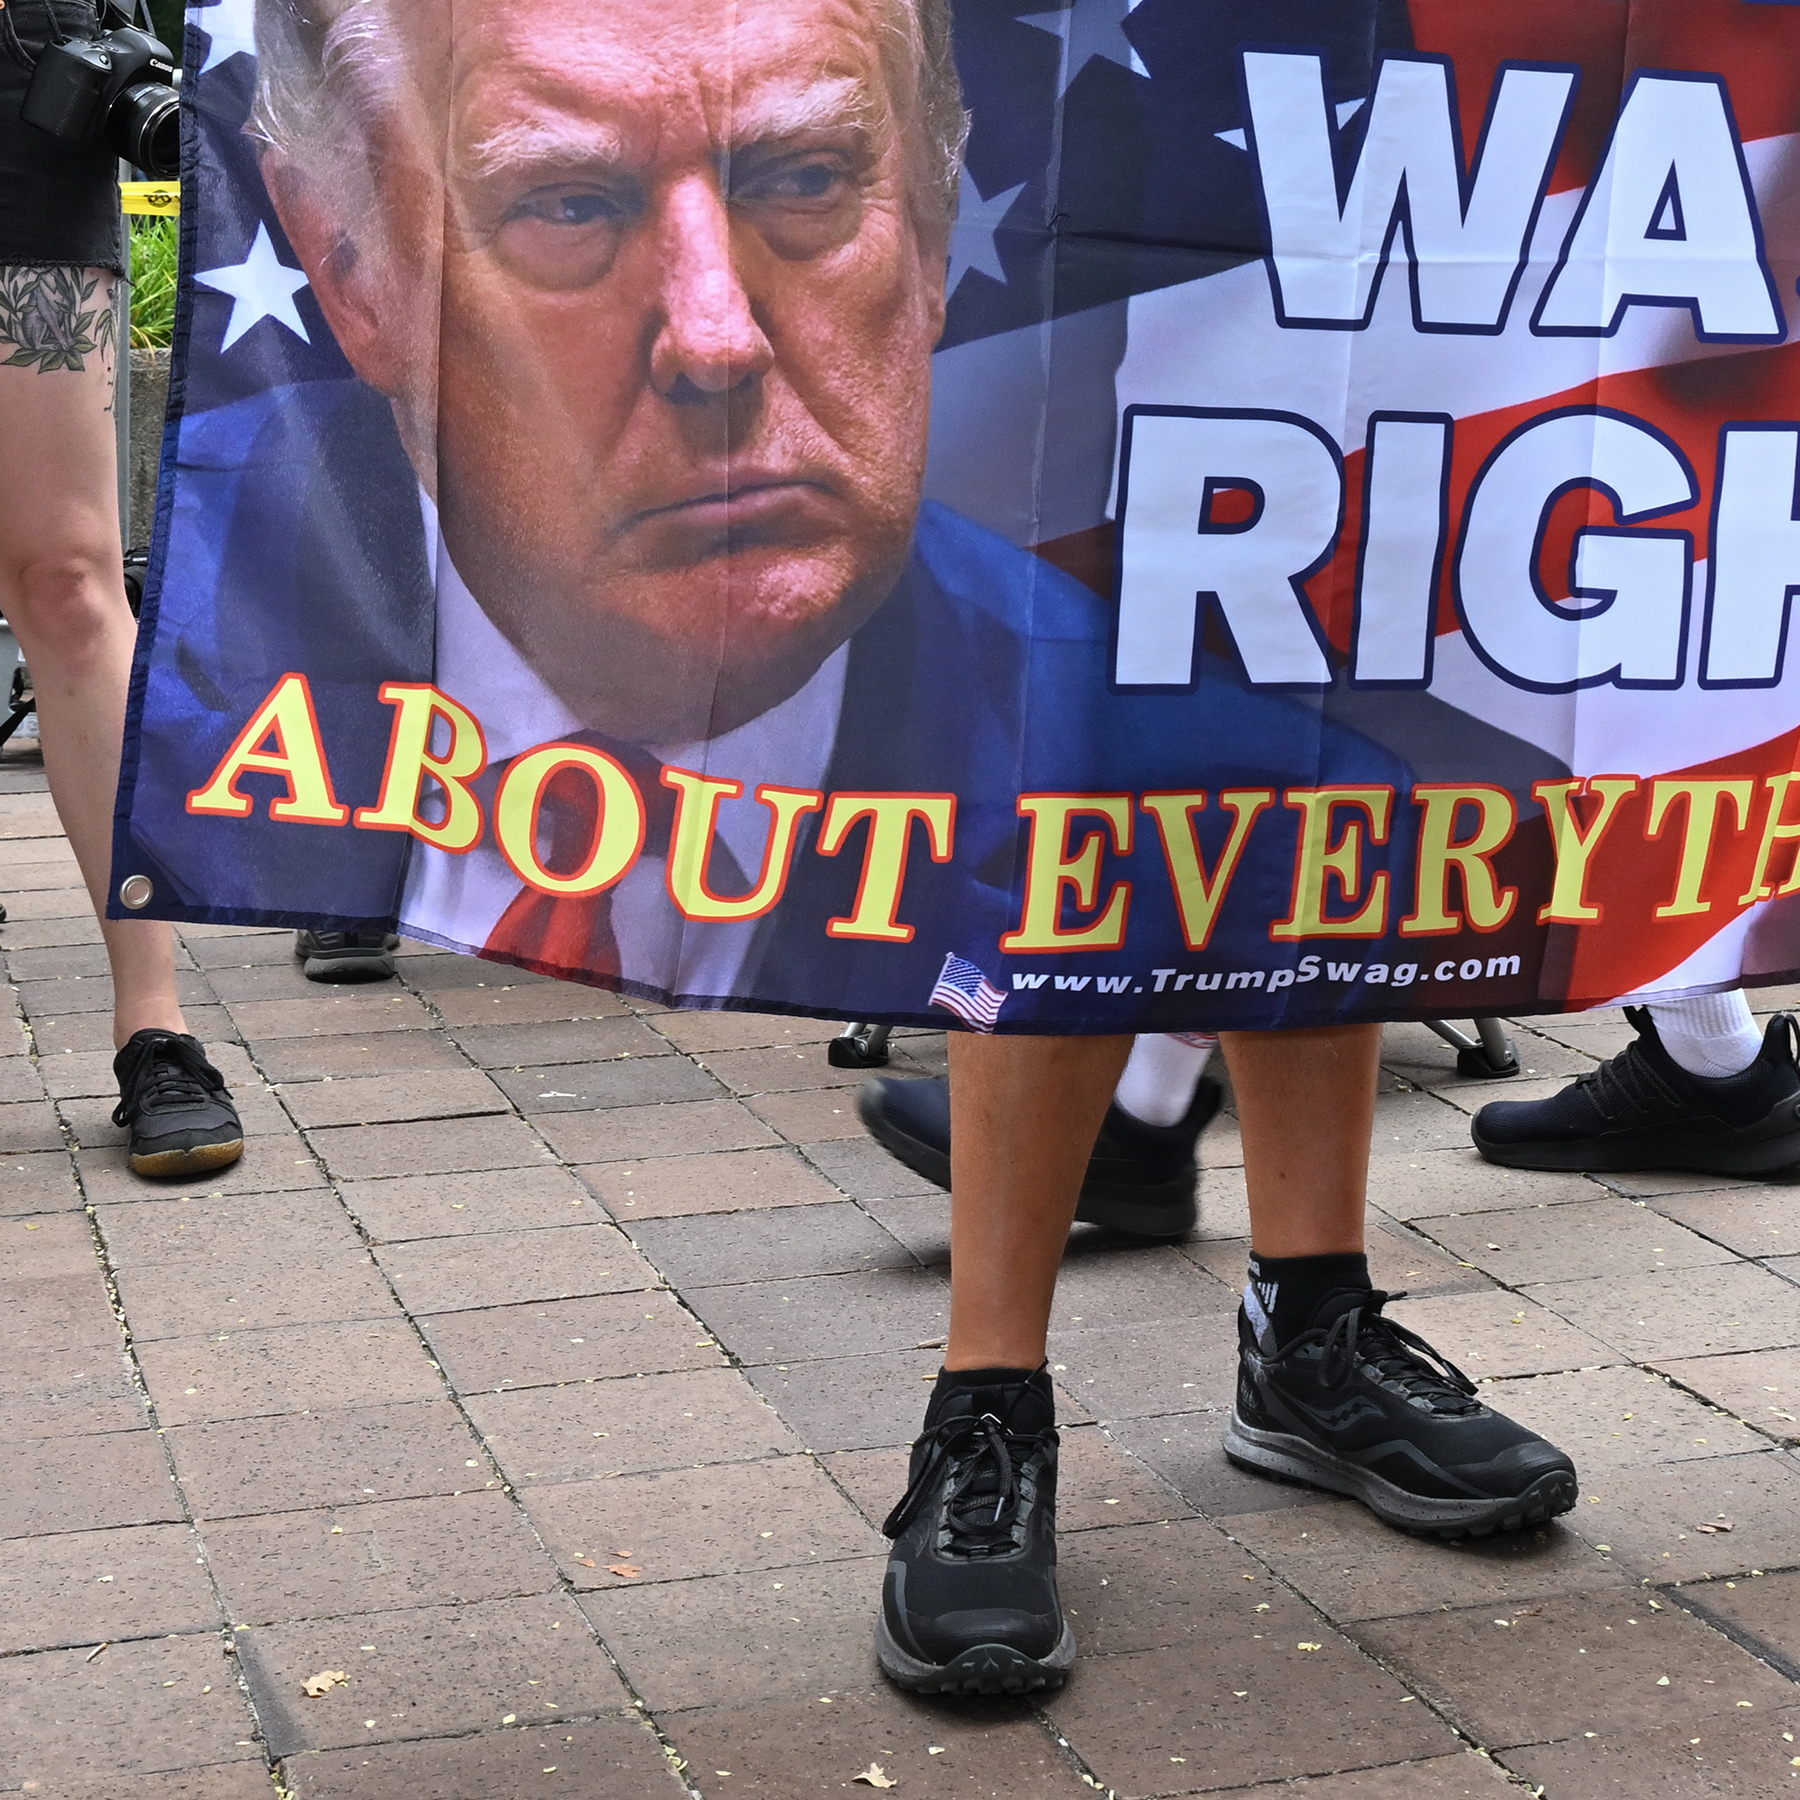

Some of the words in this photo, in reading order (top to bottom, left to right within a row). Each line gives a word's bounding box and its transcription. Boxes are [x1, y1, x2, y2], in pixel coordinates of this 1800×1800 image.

[149, 58, 174, 73] Canon
[184, 672, 958, 944] ABOUT
[1011, 950, 1521, 998] www.TrumpSwag.com
